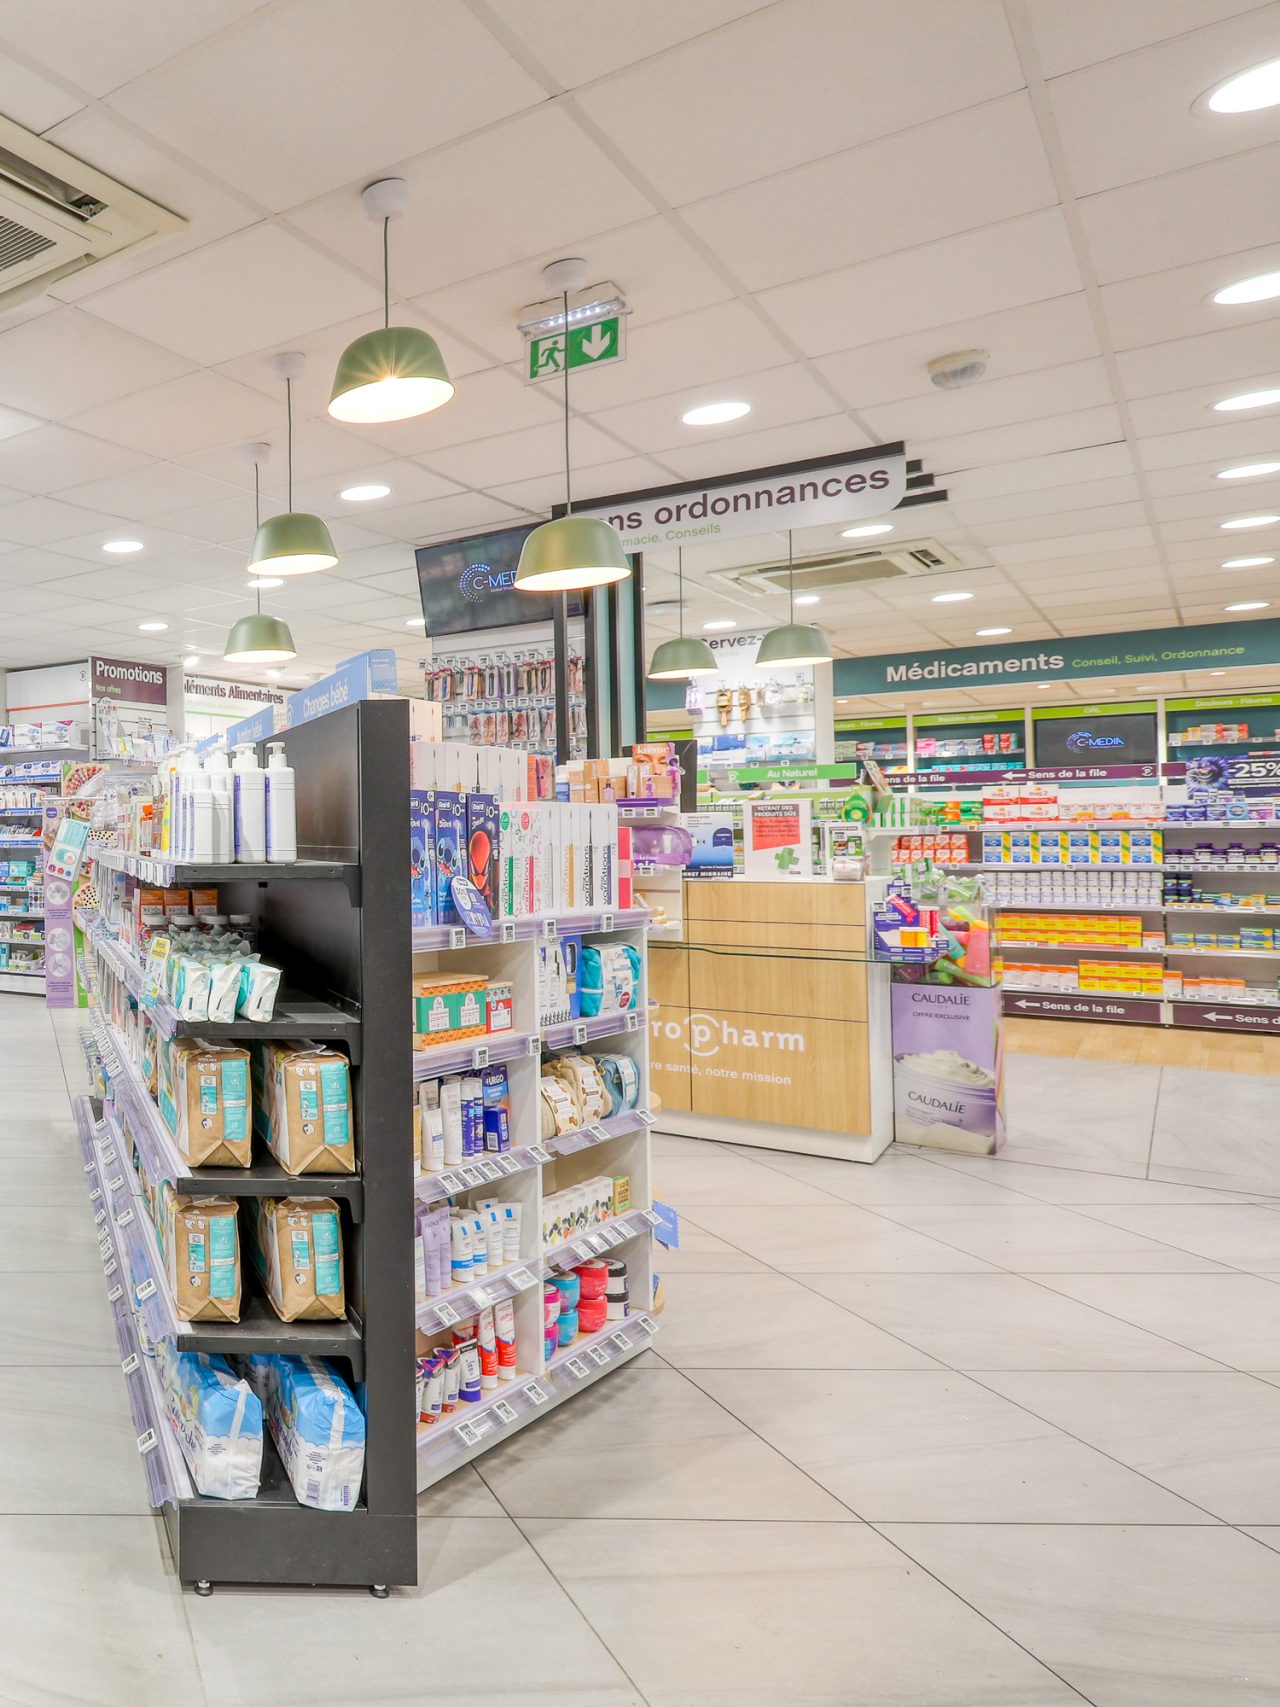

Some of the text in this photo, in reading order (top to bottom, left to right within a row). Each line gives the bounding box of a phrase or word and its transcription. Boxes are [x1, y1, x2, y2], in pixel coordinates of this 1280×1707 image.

[653, 467, 890, 527] ordonnances
[622, 522, 721, 548] macie, Conseils
[473, 570, 518, 590] C-MED
[701, 634, 765, 650] ervez-
[96, 660, 163, 685] Promotions
[886, 646, 1245, 683] Médicaments Conseil, Suivi, Ordonnance
[184, 678, 284, 705] léments Alimentaires
[303, 679, 349, 719] Changes bébé
[1077, 737, 1125, 746] C-MEDIA
[767, 768, 818, 778] Au Naturel
[884, 774, 946, 784] ens de la file
[1028, 767, 1108, 780] Sens de la file
[912, 1011, 970, 1021] OFFRE EXCLUSIVE
[1042, 1001, 1125, 1015] Sens de la file
[1235, 1013, 1280, 1025] Sens d
[649, 1016, 805, 1052] ropharm
[488, 1074, 504, 1085] URGO
[665, 1061, 702, 1077] santé,
[705, 1067, 738, 1079] notre
[741, 1071, 792, 1086] mission
